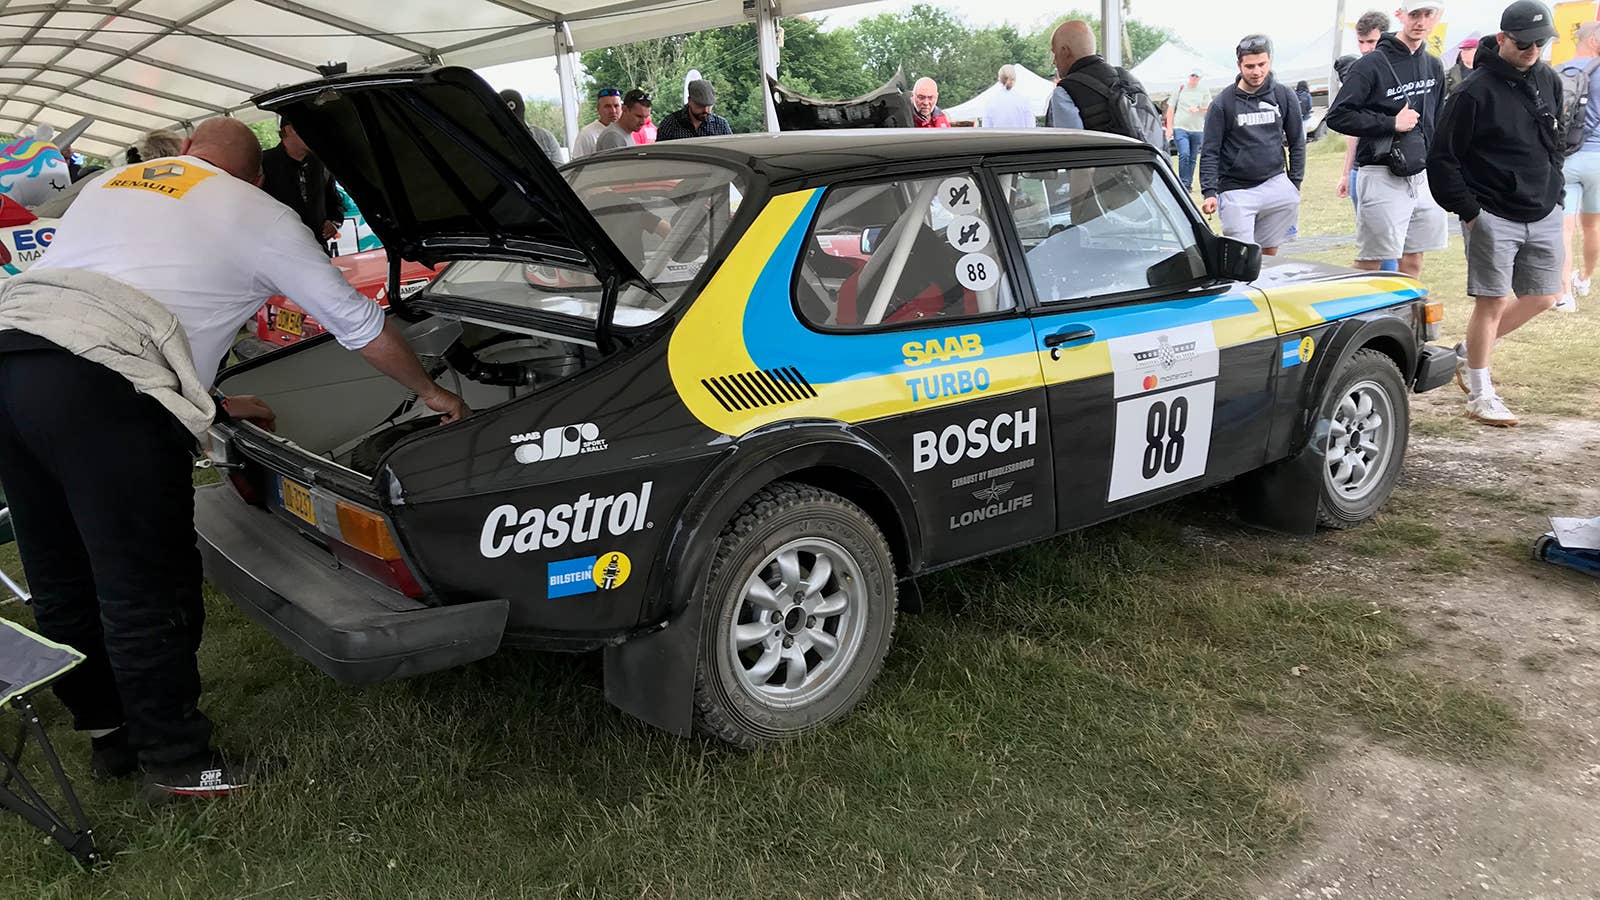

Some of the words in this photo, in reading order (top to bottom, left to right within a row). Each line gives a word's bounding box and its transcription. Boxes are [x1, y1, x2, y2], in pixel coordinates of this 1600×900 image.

[110, 180, 180, 194] RENAULT
[18, 249, 46, 262] MA
[967, 262, 987, 282] 88
[902, 333, 984, 367] SAAB
[906, 367, 990, 402] TURBO
[510, 431, 541, 444] SAAB
[583, 439, 606, 448] SPORT
[913, 407, 1037, 473] BOSCH
[1142, 396, 1188, 480] 88
[587, 443, 609, 453] RALLY
[951, 473, 978, 489] EXHAUST
[978, 470, 987, 481] BY
[480, 481, 653, 559] Castrol
[950, 494, 1033, 529] LONGLIFE
[550, 570, 592, 586] BILSTEIN
[200, 770, 222, 781] OMP
